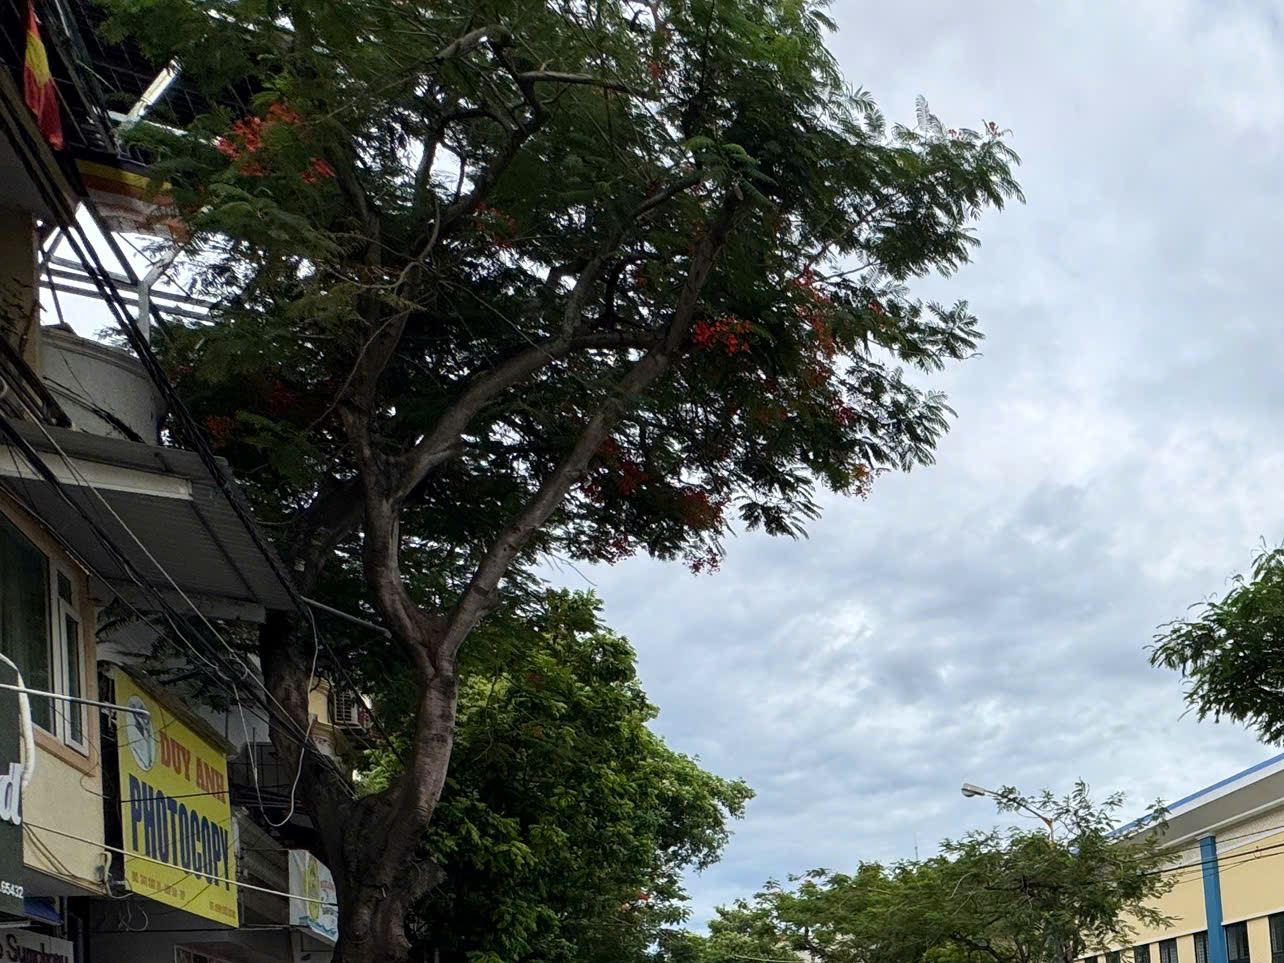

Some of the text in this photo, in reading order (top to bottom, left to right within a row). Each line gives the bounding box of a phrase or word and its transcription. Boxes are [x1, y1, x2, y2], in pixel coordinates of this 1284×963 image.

[160, 730, 226, 805] DUY ANH
[128, 772, 230, 892] PHOTOCOPY
